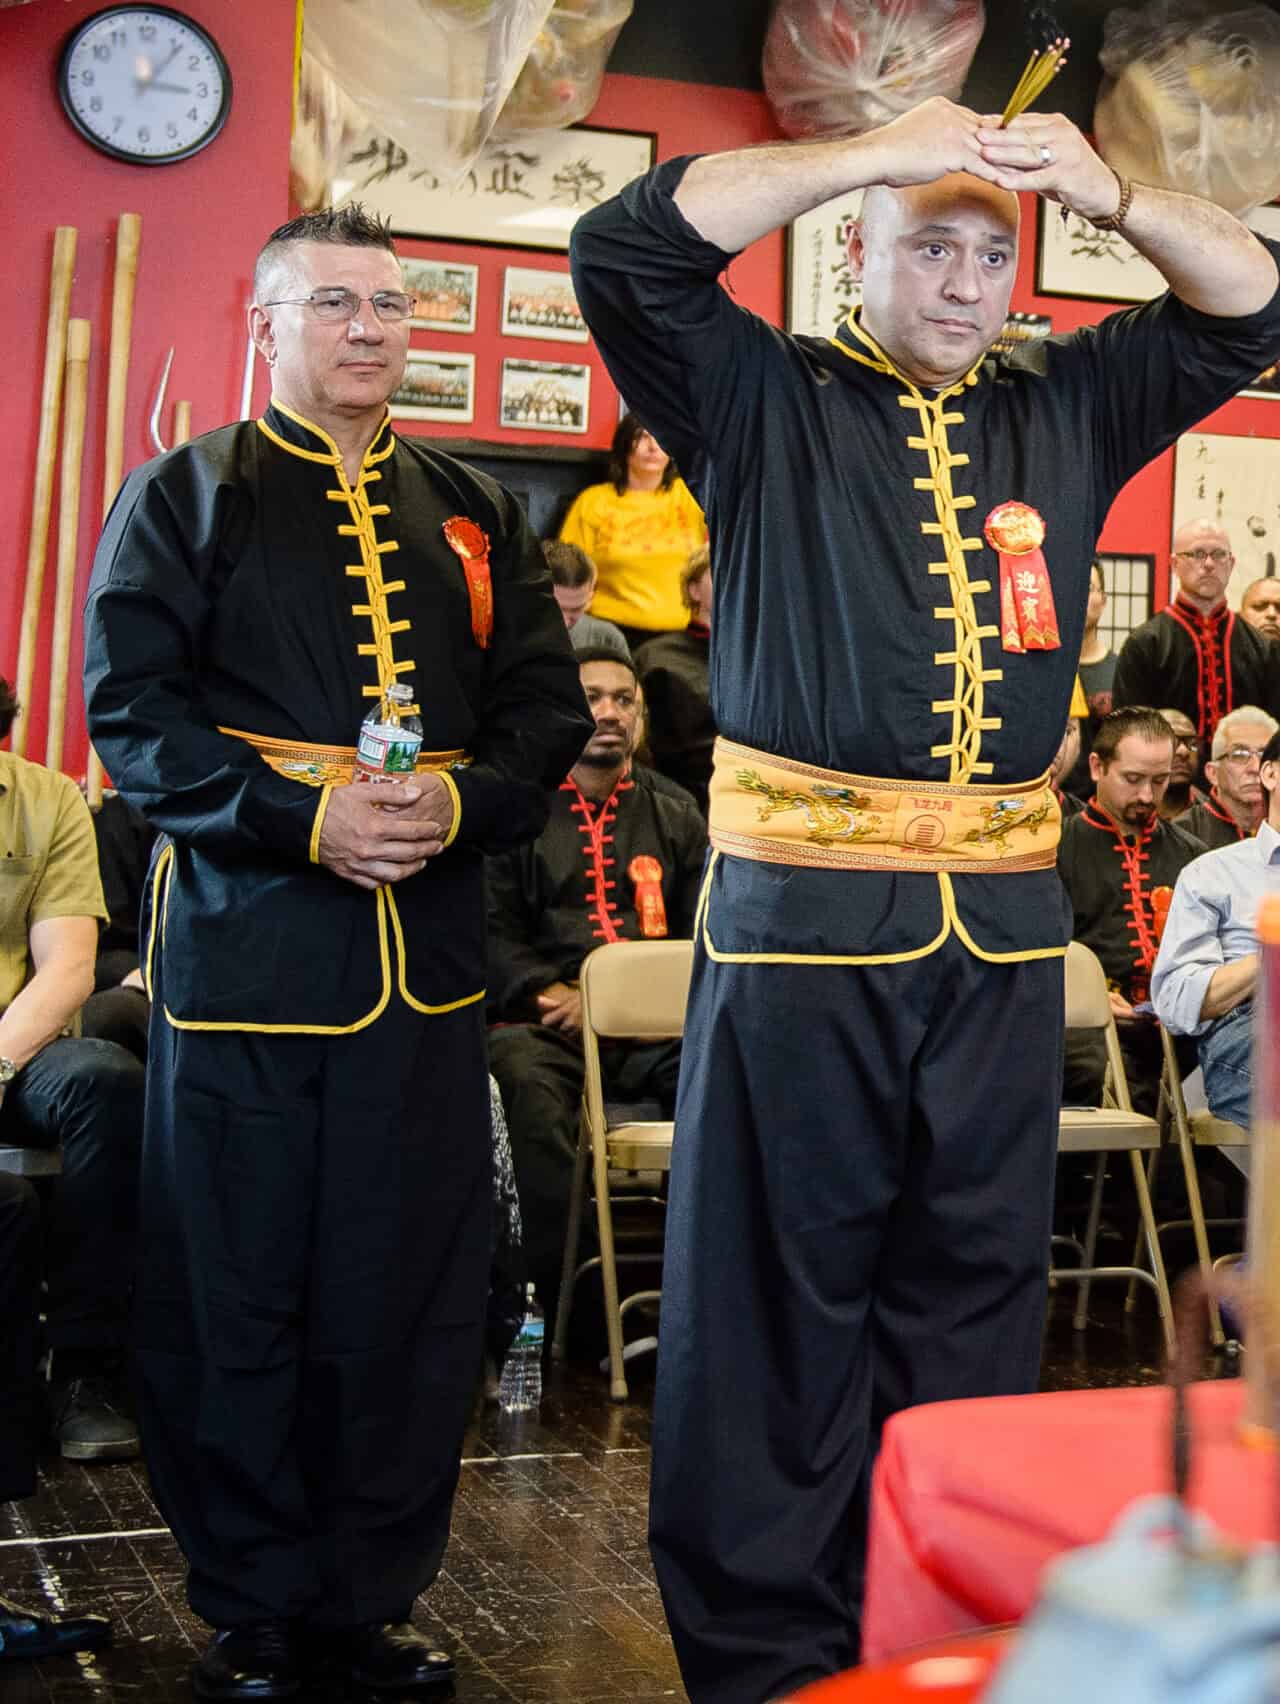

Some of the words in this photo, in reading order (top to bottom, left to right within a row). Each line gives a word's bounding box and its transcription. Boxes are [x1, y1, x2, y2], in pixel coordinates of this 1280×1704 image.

[111, 31, 127, 47] 11
[139, 26, 157, 41] 12
[93, 44, 111, 63] 10
[188, 55, 201, 71] 2
[82, 69, 95, 86] 9
[196, 82, 209, 98] 3
[90, 96, 103, 112] 8
[186, 106, 199, 121] 4
[112, 115, 124, 133] 7
[166, 122, 179, 139] 5
[138, 126, 150, 143] 6
